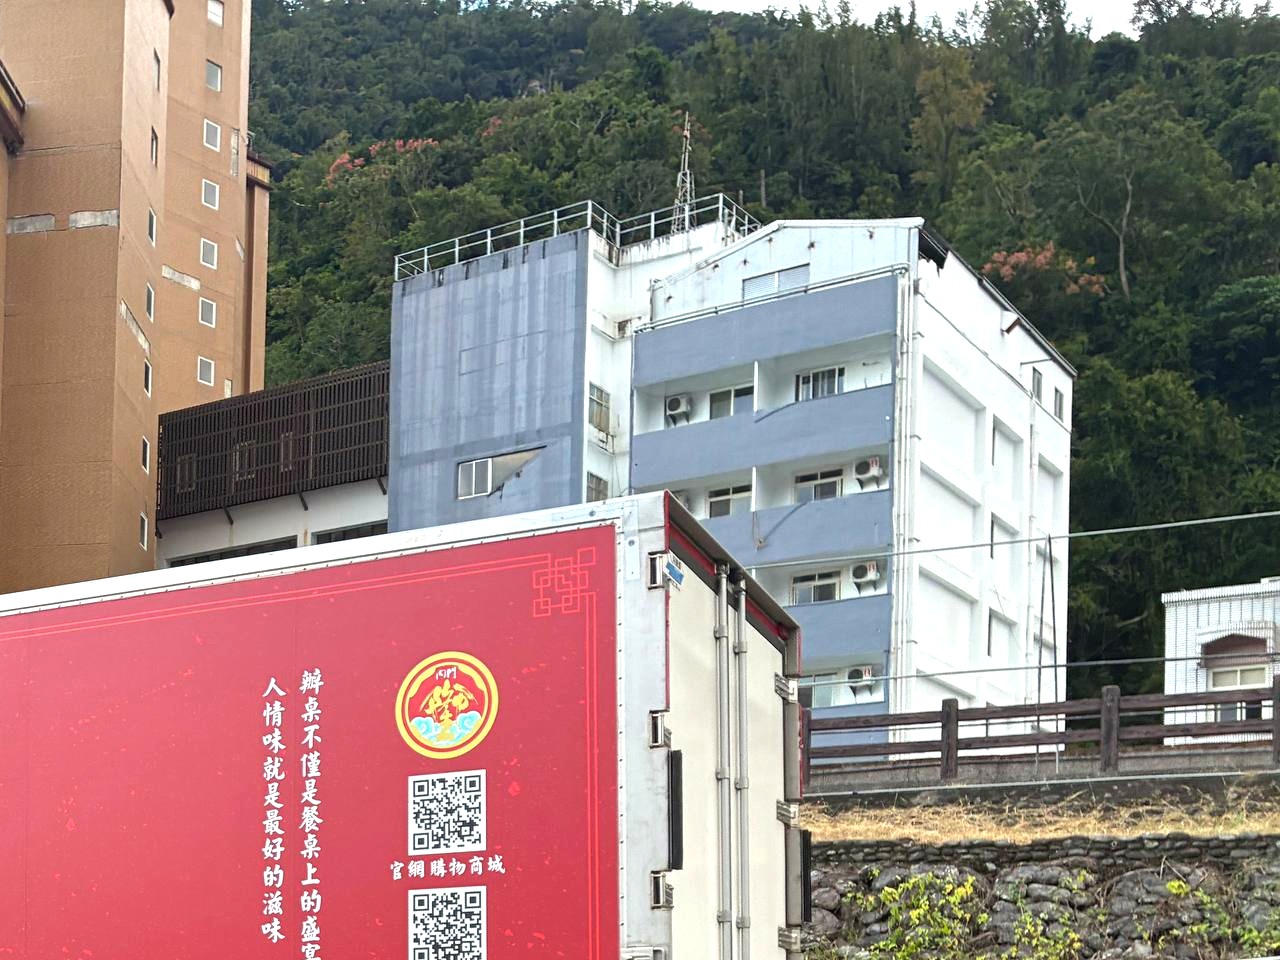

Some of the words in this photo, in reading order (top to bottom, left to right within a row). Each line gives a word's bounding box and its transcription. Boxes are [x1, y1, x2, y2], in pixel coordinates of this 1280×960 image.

[261, 677, 287, 944] 人情味就是最好的滋味
[390, 854, 506, 881] 官網購物商城
